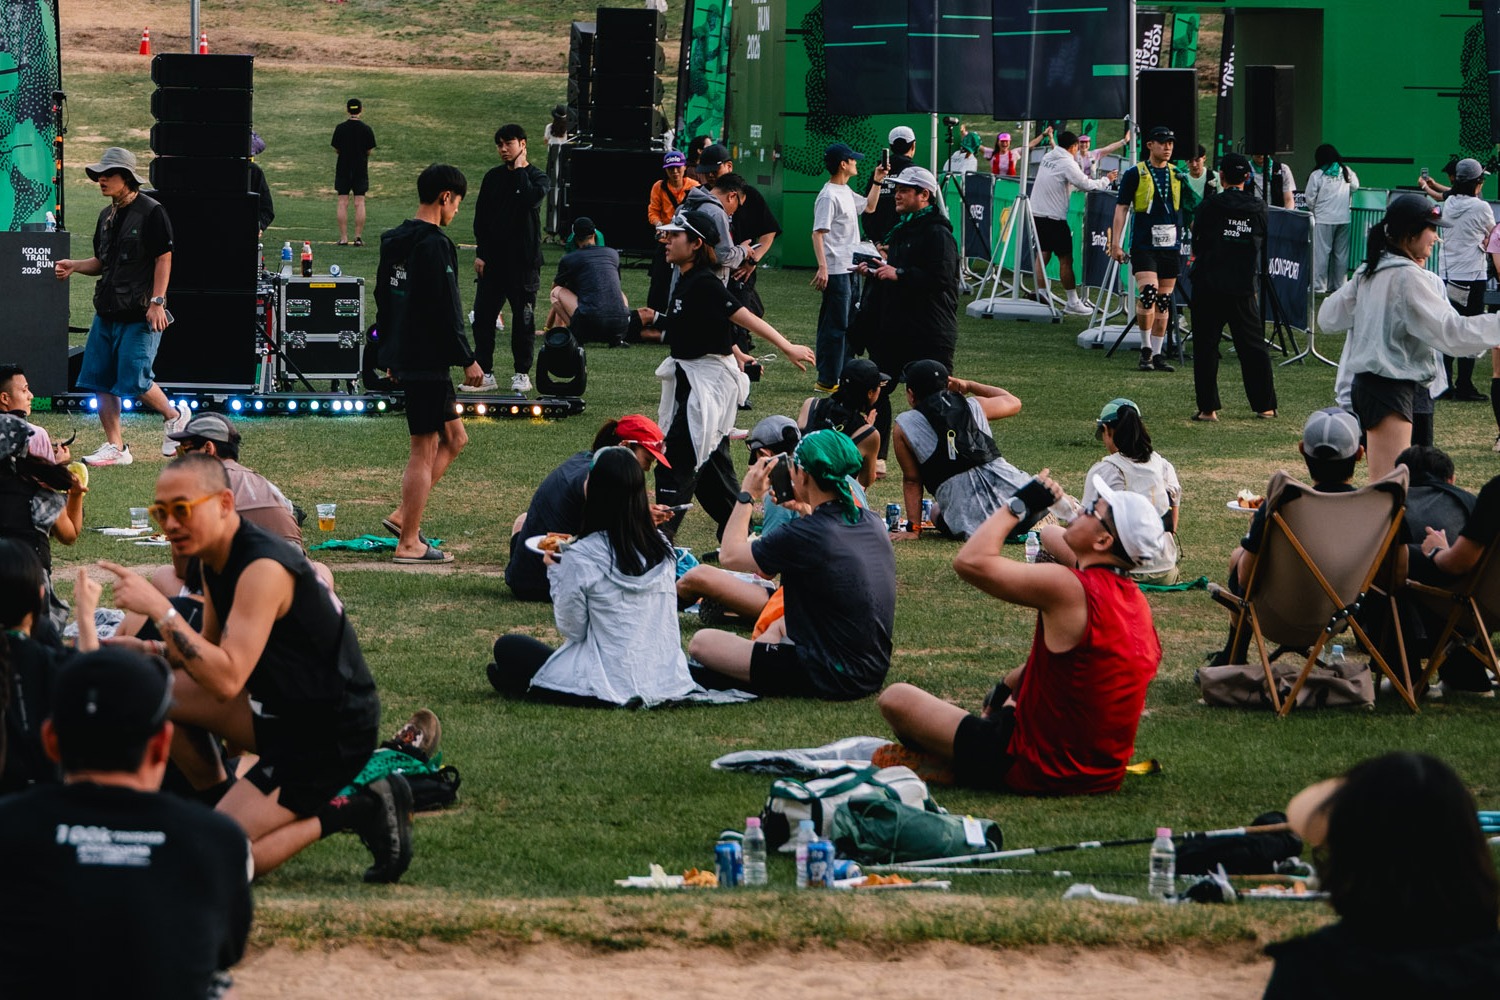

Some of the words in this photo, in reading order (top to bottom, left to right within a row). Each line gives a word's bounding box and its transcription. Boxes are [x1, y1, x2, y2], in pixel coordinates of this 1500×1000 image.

[757, 5, 771, 32] RUN
[746, 33, 761, 60] 2026
[1148, 23, 1163, 70] KOLO
[1041, 160, 1058, 170] TAFF
[1228, 218, 1248, 227] TRAIL
[1236, 225, 1252, 233] RUN
[1223, 230, 1241, 238] 2026
[21, 247, 52, 255] KOLON
[21, 267, 42, 275] 2026
